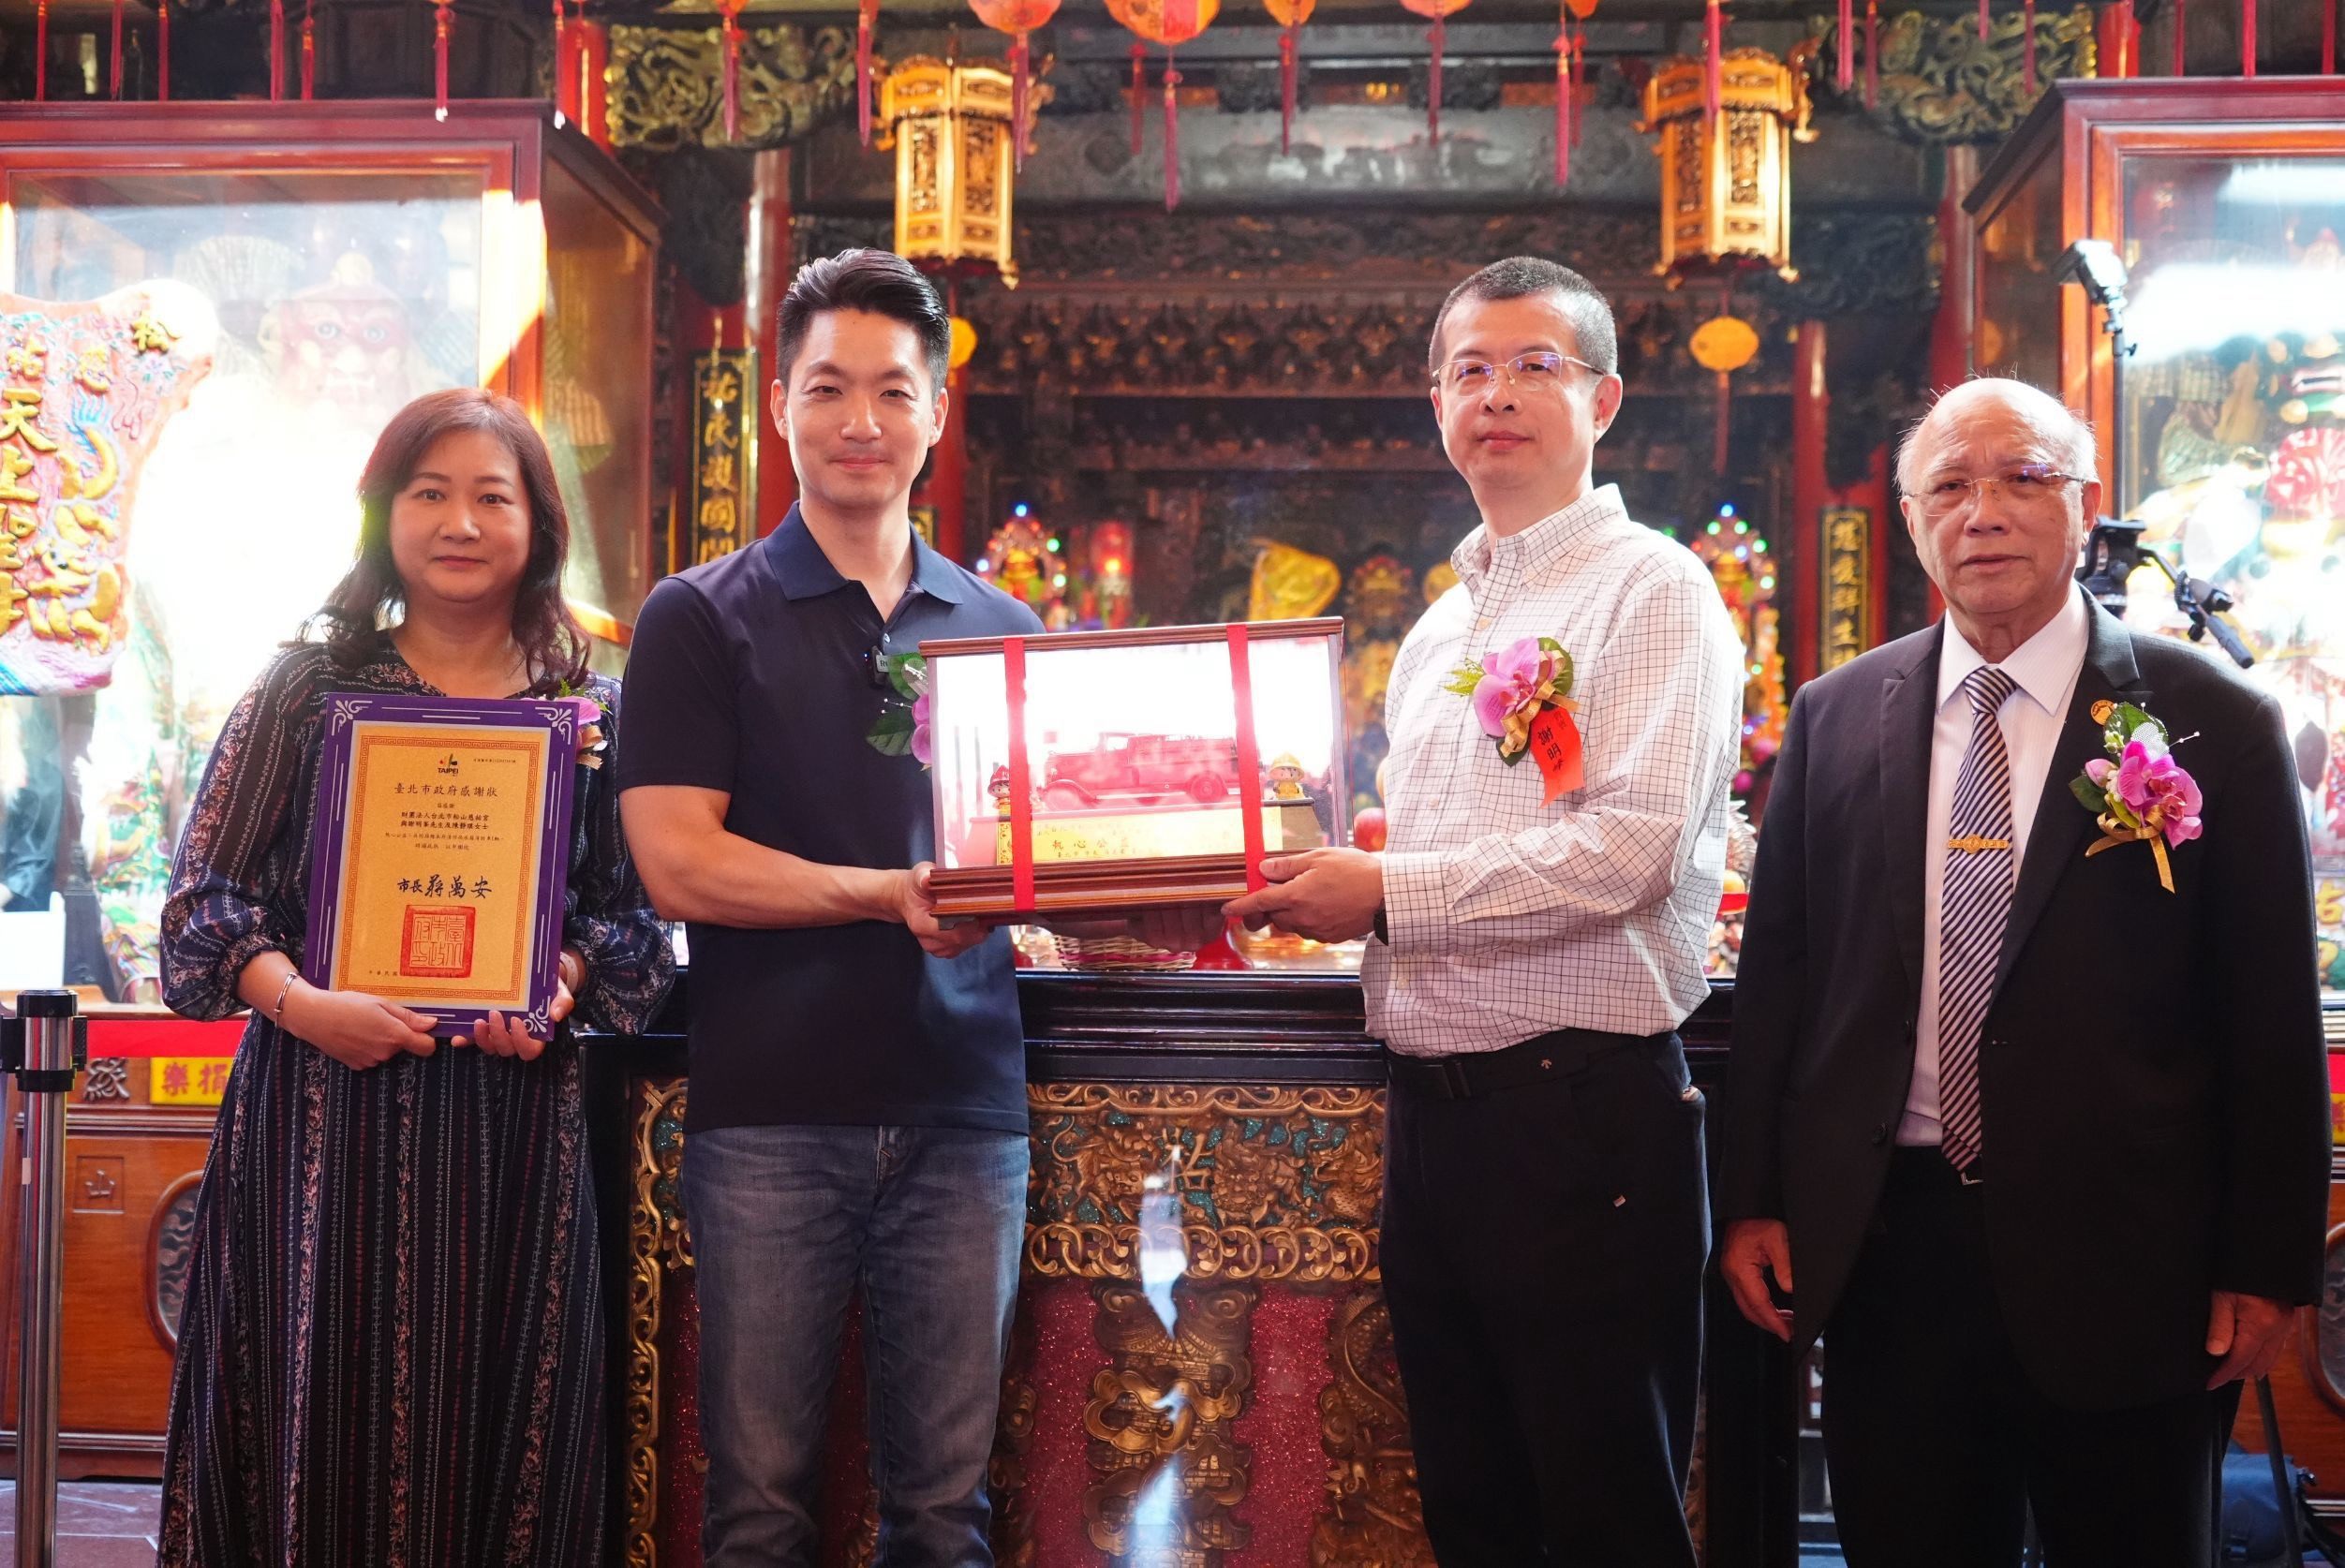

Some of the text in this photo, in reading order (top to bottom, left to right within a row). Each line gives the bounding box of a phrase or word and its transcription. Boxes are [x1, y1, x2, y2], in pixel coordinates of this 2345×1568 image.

[394, 783, 498, 797] 臺北市政府感謝狀
